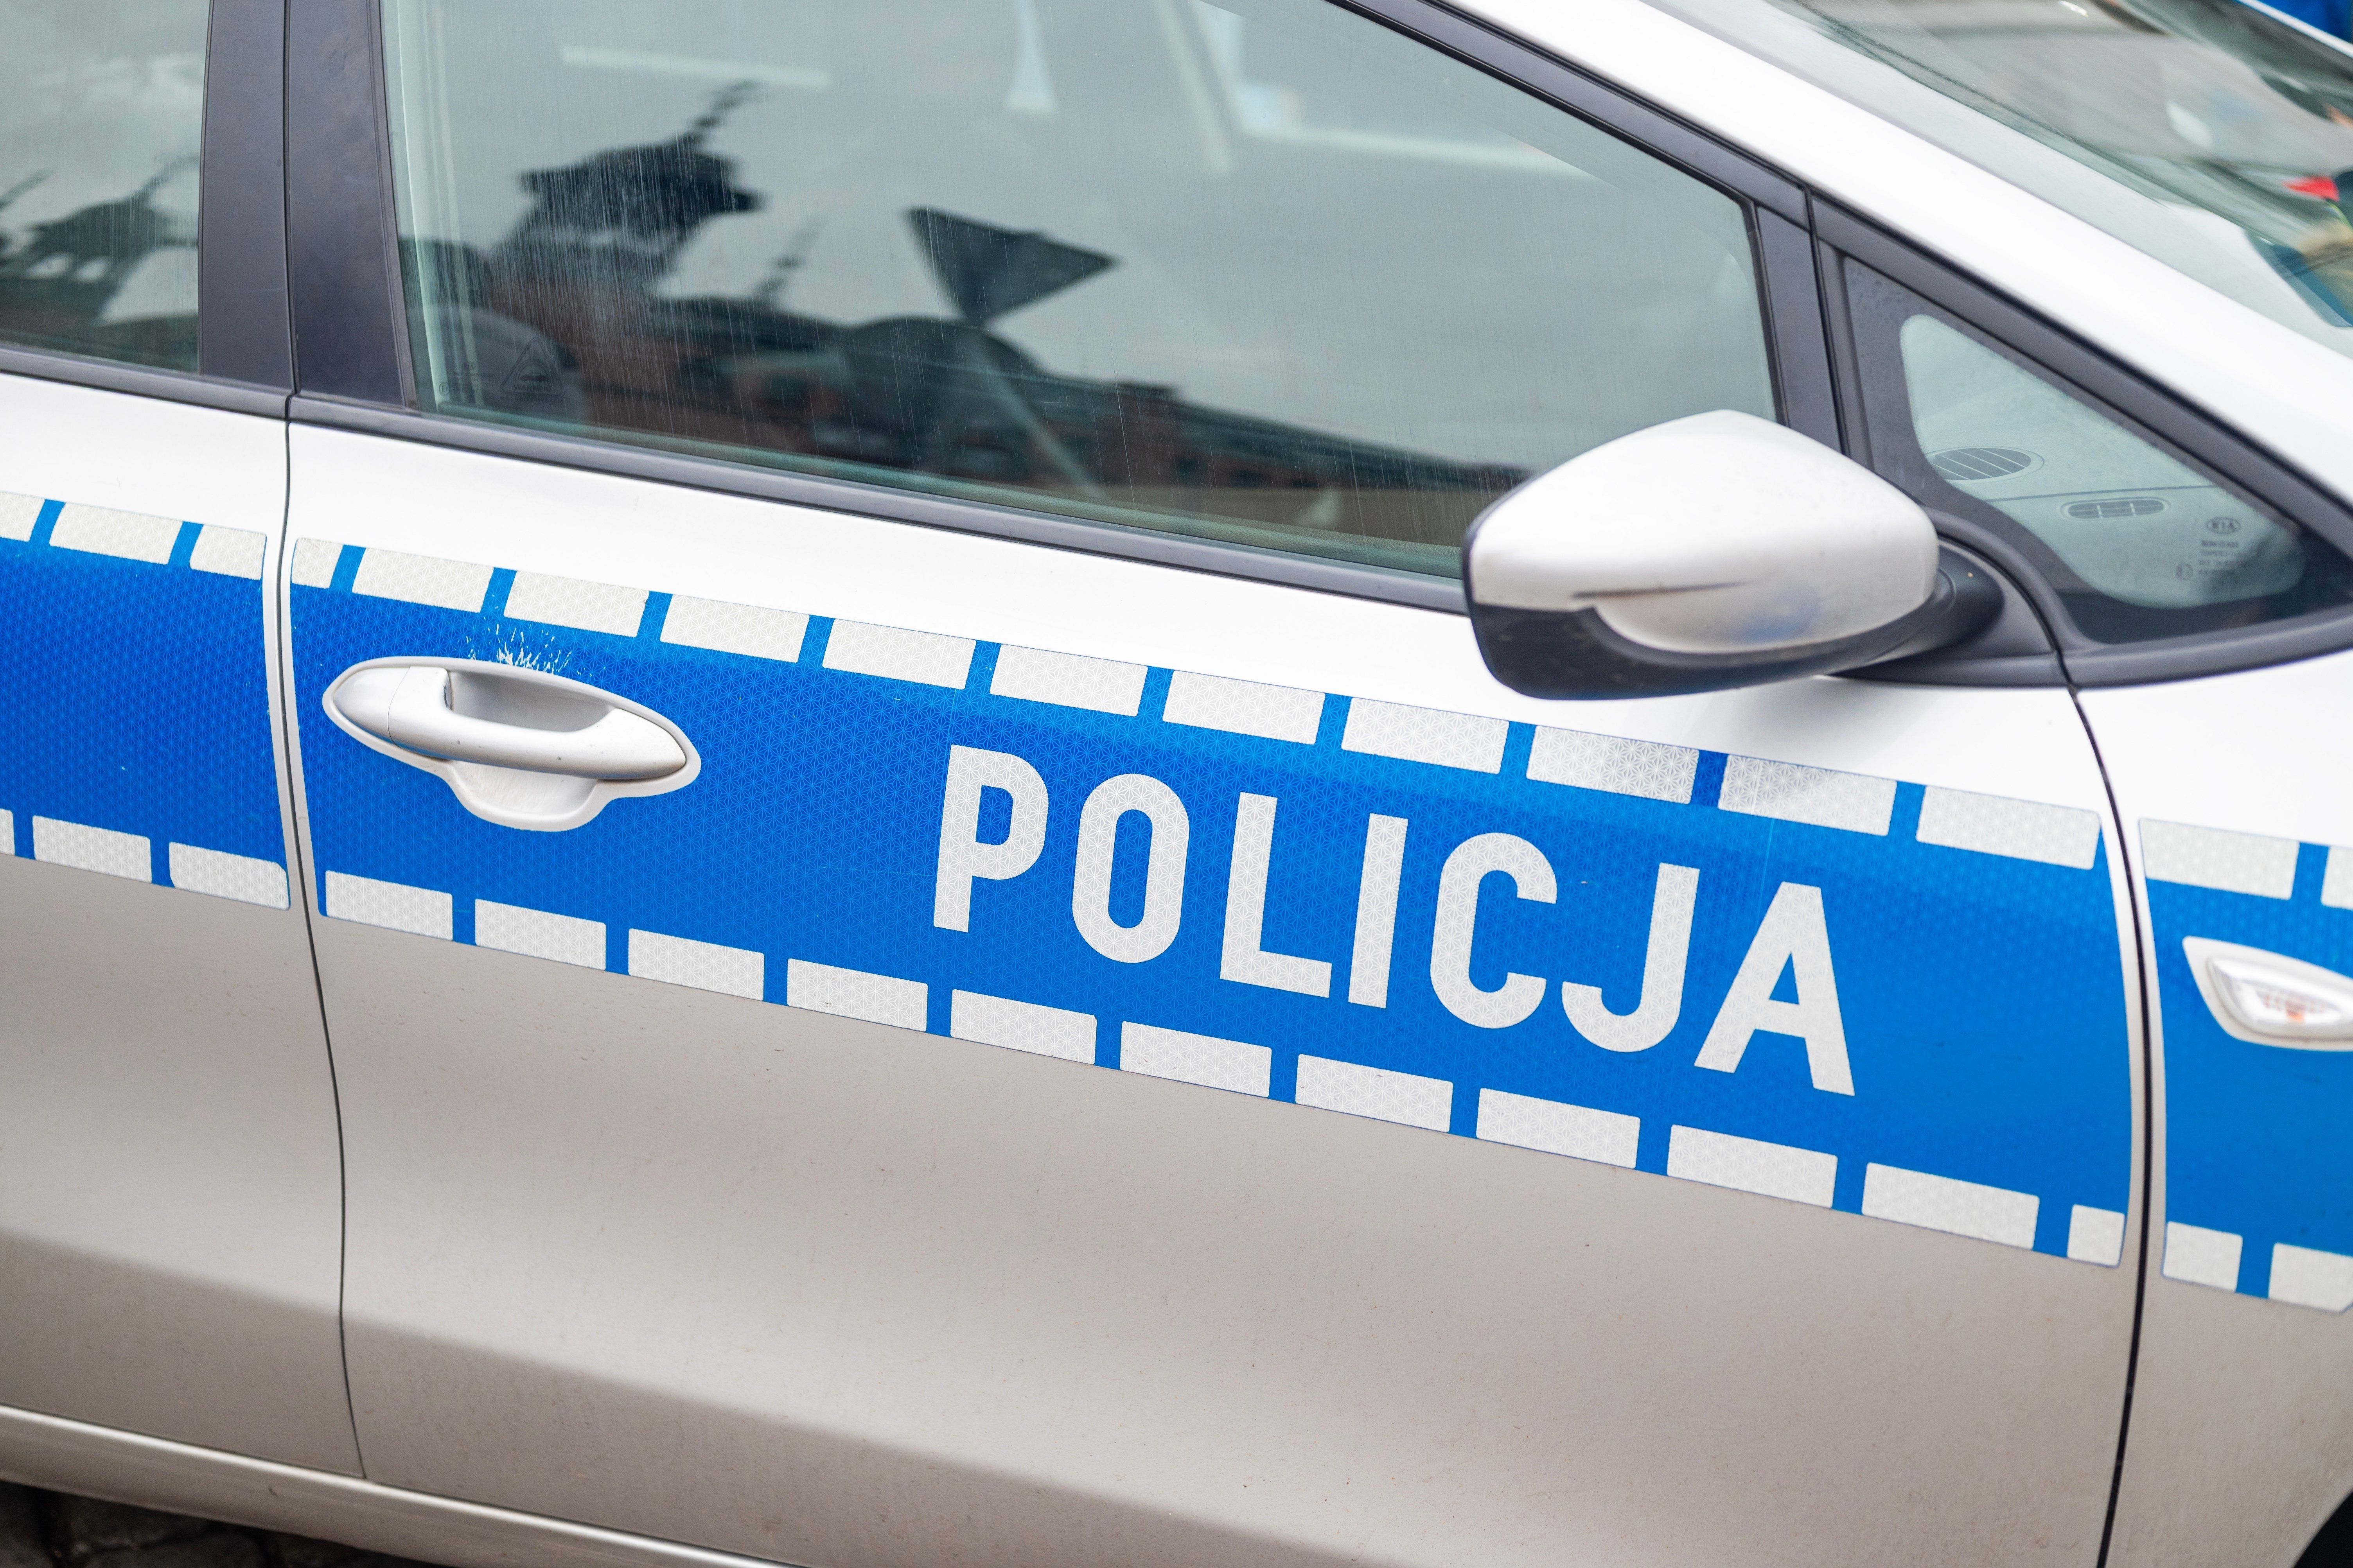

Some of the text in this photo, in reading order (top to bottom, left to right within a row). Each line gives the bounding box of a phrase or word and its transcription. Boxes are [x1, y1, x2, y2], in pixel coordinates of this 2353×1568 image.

[514, 384, 551, 392] WARNING
[2210, 518, 2237, 533] KIA
[934, 745, 1855, 1096] POLICJA
